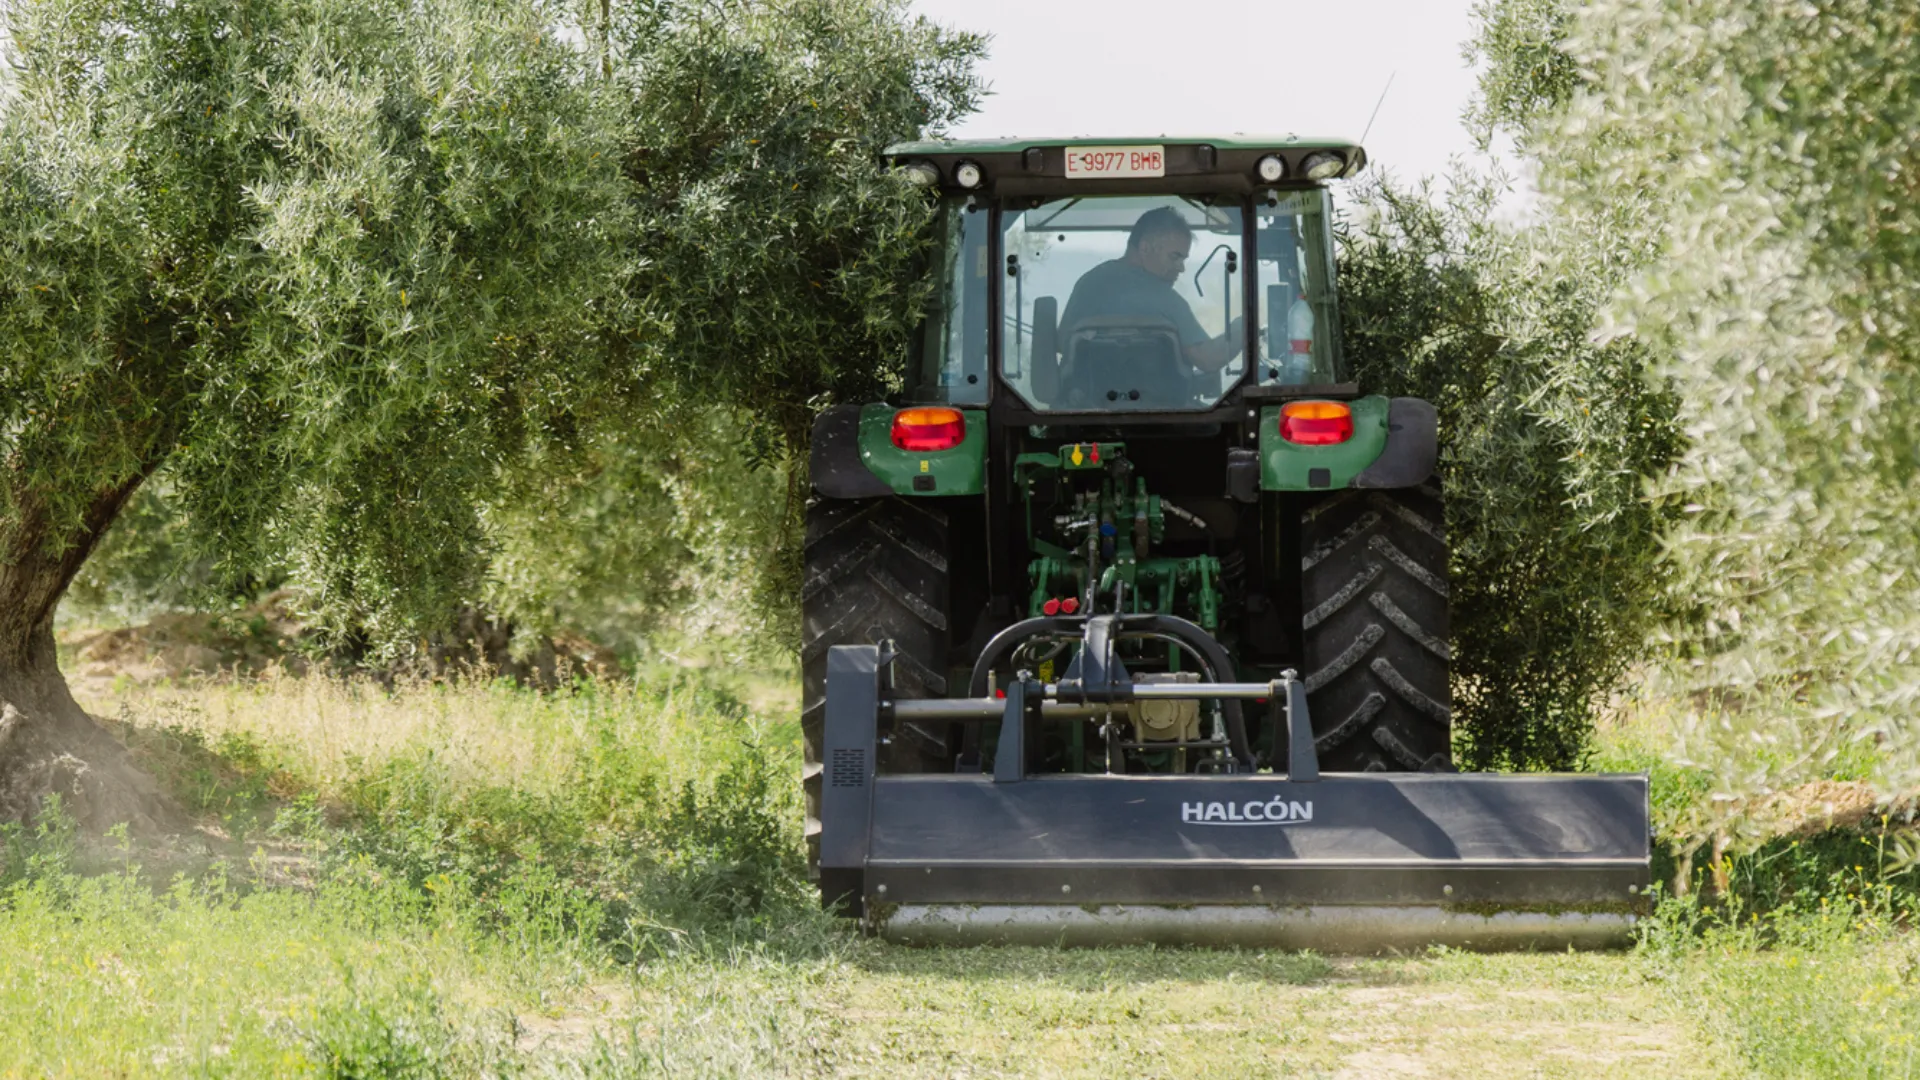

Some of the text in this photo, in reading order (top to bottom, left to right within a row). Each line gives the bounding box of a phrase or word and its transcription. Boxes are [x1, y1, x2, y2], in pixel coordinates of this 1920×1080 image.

[1067, 151, 1162, 172] E 9977 BHB
[1181, 794, 1313, 821] HALCÓN
